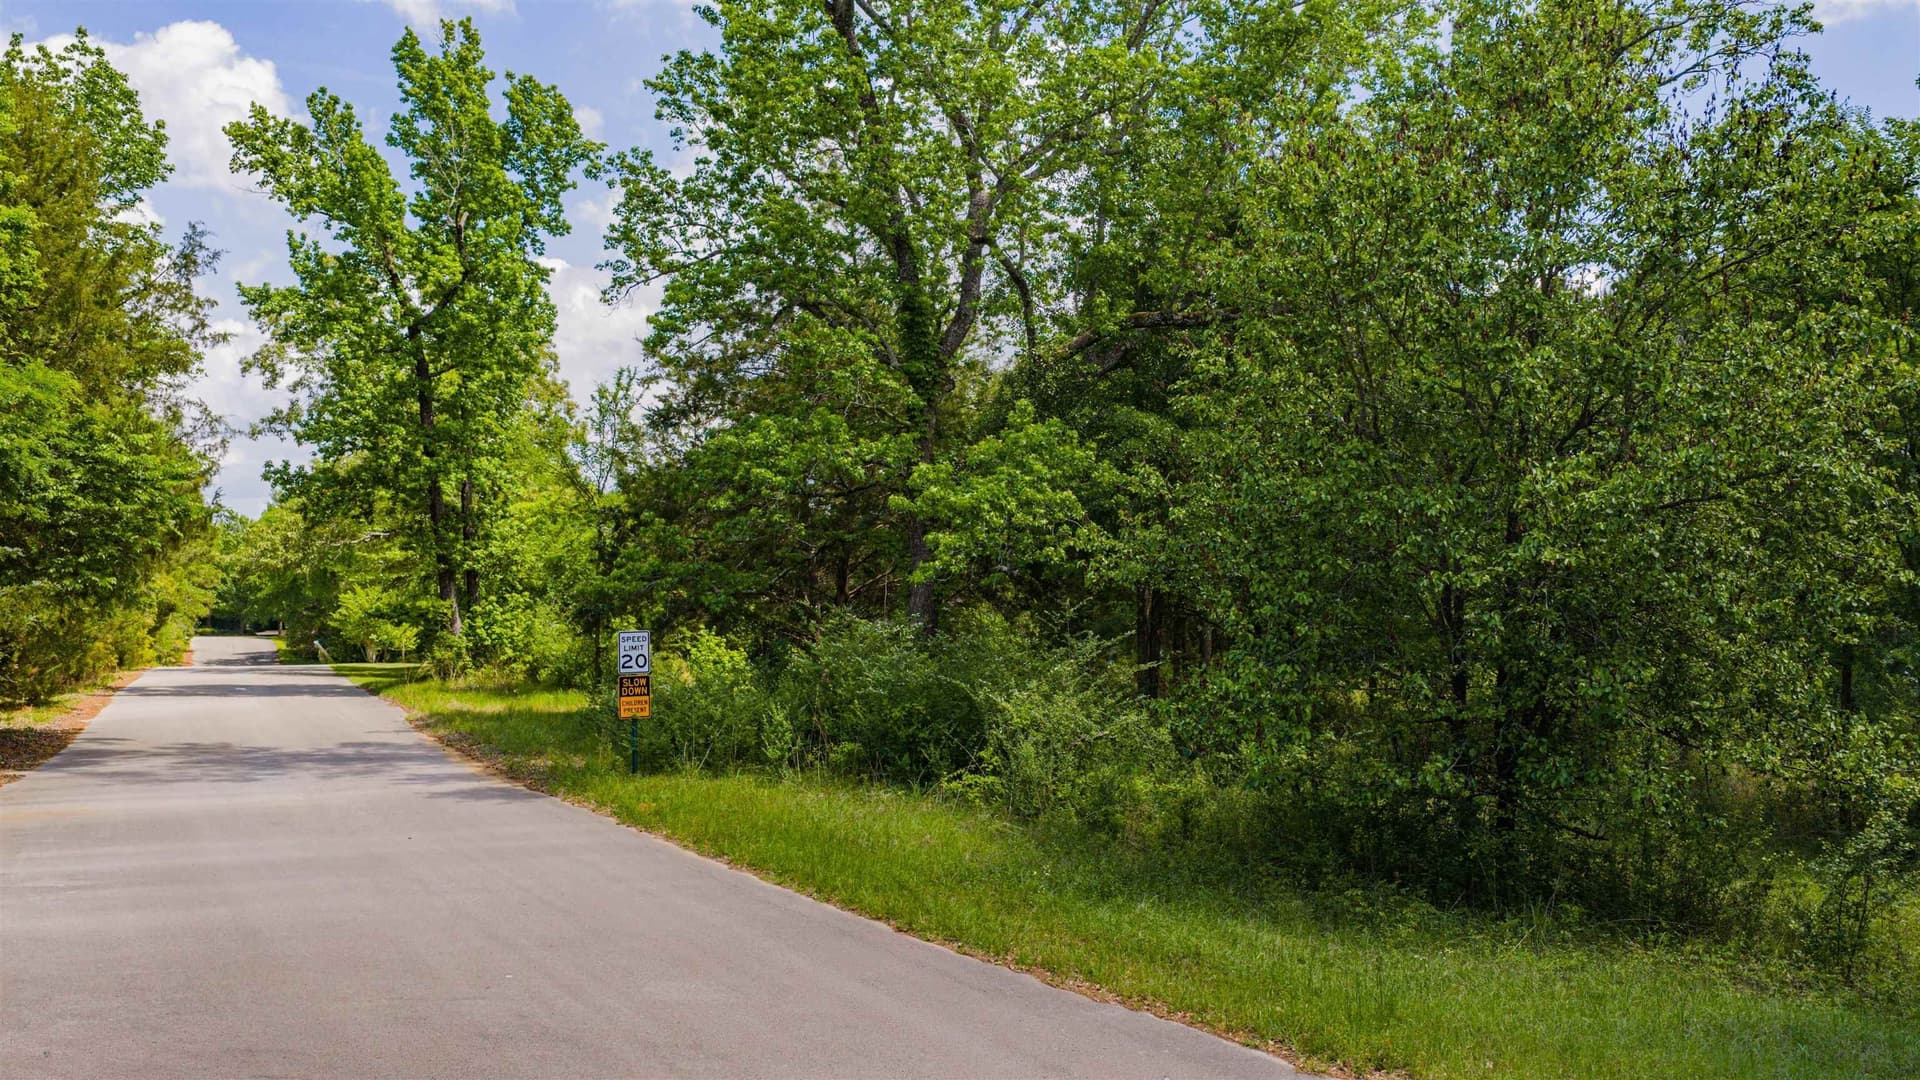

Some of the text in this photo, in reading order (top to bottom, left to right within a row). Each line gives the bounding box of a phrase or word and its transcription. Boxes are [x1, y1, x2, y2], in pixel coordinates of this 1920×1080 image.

[621, 654, 647, 669] 20
[622, 678, 646, 687] SLOW
[621, 687, 648, 696] DOWN
